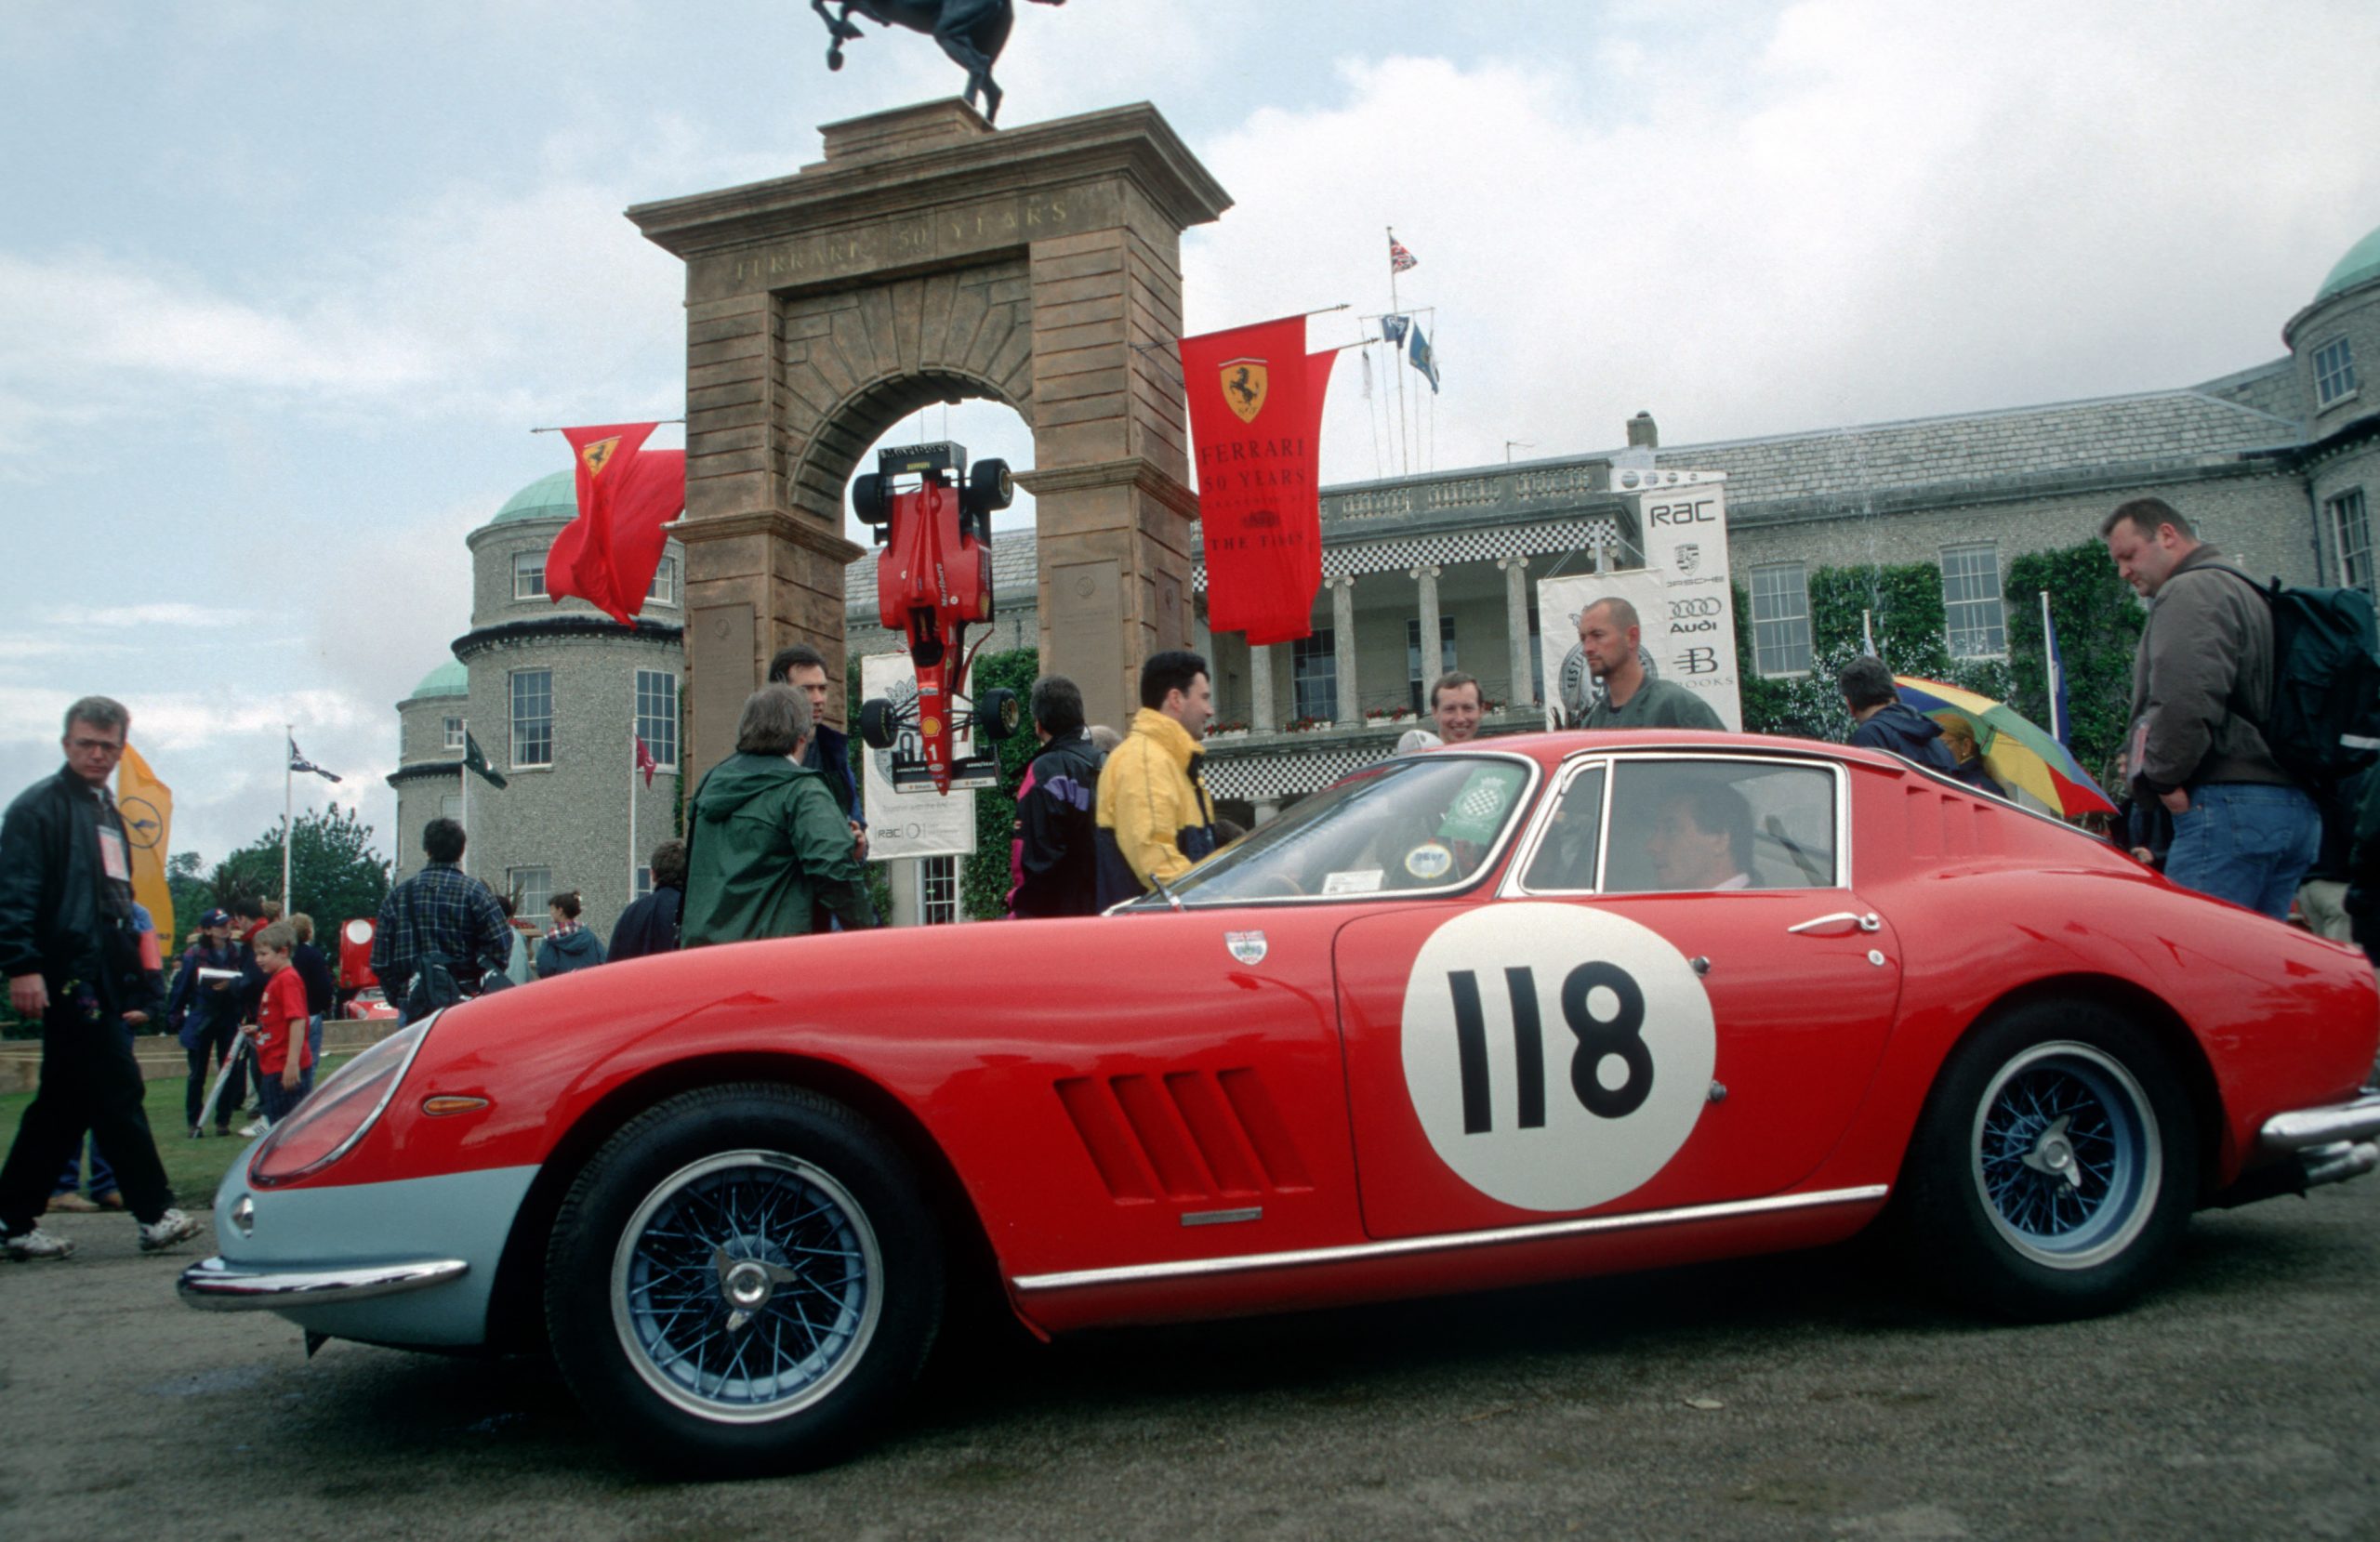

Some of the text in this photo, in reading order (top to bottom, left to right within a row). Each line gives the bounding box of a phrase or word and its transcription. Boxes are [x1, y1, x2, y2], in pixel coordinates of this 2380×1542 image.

[898, 227, 927, 247] 50
[951, 200, 1067, 239] YEARS
[1202, 438, 1303, 465] FERRARI
[1204, 468, 1303, 493] 50 YEARS
[1210, 536, 1248, 550] THE
[1667, 575, 1724, 587] ORSCHE
[1671, 620, 1717, 633] Audi
[929, 744, 937, 760] 1
[1447, 960, 1654, 1135] 118
